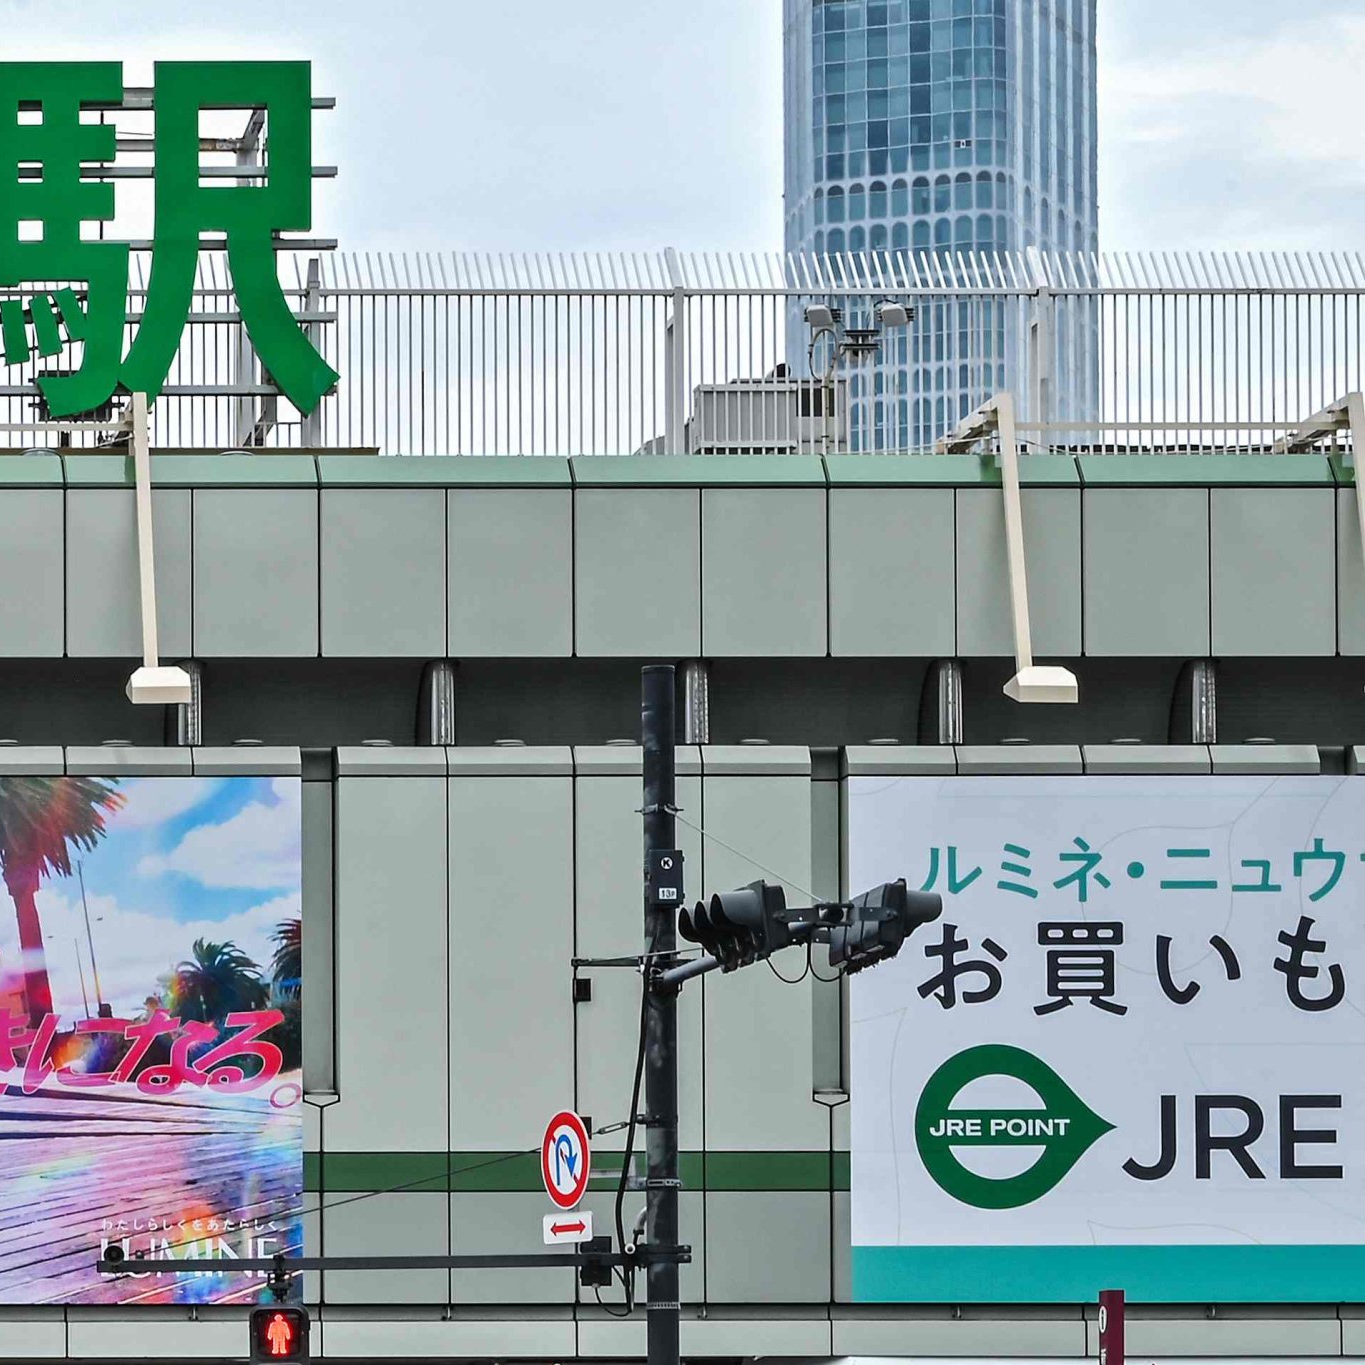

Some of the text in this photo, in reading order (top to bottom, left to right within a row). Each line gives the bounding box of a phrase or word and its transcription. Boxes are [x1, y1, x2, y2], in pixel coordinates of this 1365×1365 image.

[919, 836, 1365, 902] ルミネ・ニュウ
[929, 1118, 1070, 1137] JRE POINT
[1121, 1095, 1344, 1179] JRE
[100, 1238, 278, 1278] LUMINE
